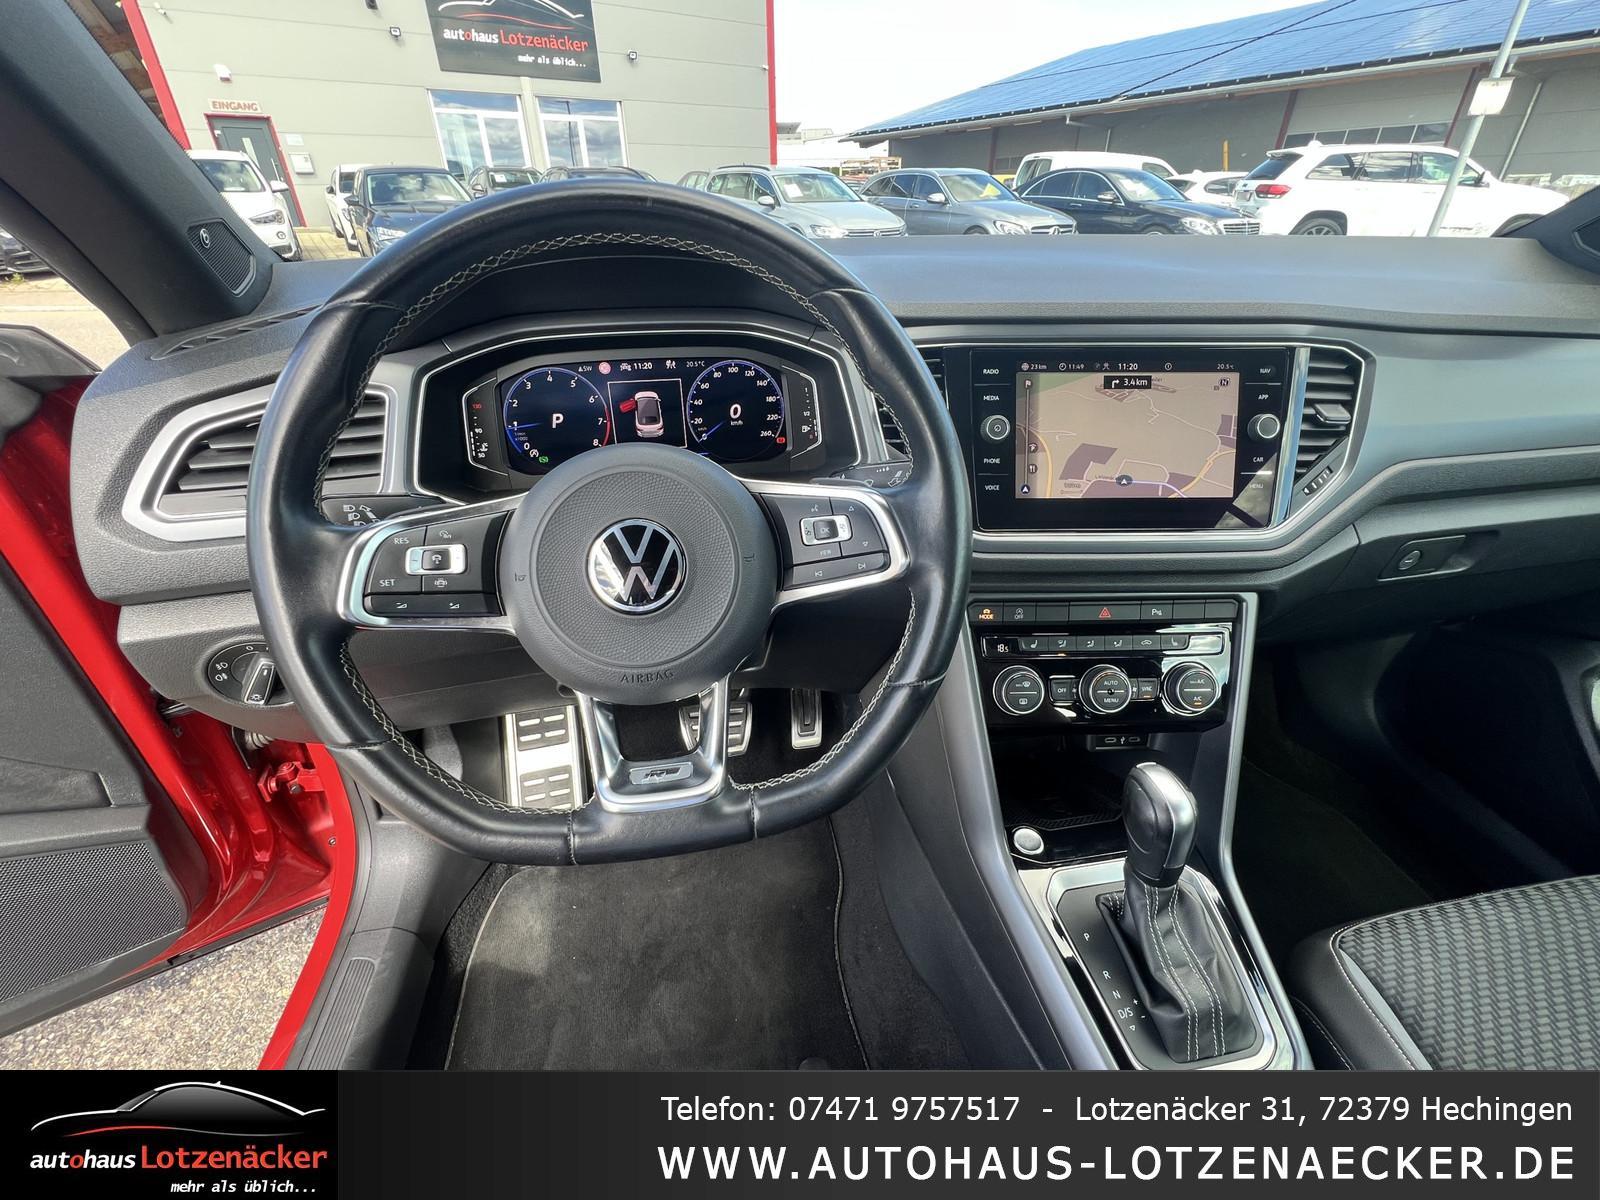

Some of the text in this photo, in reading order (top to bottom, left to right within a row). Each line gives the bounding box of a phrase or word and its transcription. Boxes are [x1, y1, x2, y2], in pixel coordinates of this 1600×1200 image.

[443, 28, 588, 51] autohaus Lotzenäcker
[517, 54, 535, 63] mehr
[537, 55, 550, 65] als
[212, 100, 258, 111] EINGANG
[634, 362, 653, 370] 11:20
[546, 374, 553, 382] 4
[1136, 378, 1148, 386] km
[525, 381, 532, 390] 3
[570, 379, 576, 388] 5
[512, 399, 518, 407] 2
[588, 394, 595, 403] 6
[766, 395, 777, 403] 180
[729, 403, 742, 419] 0
[552, 413, 564, 429] P
[598, 417, 603, 425] 7
[523, 442, 530, 450] 0
[592, 438, 599, 447] 8
[394, 537, 410, 545] RES
[379, 579, 395, 587] SET
[619, 669, 674, 684] AIRBAG
[1083, 932, 1090, 941] P
[1102, 970, 1111, 980] R
[1112, 989, 1121, 999] N
[1118, 1007, 1134, 1019] D/S
